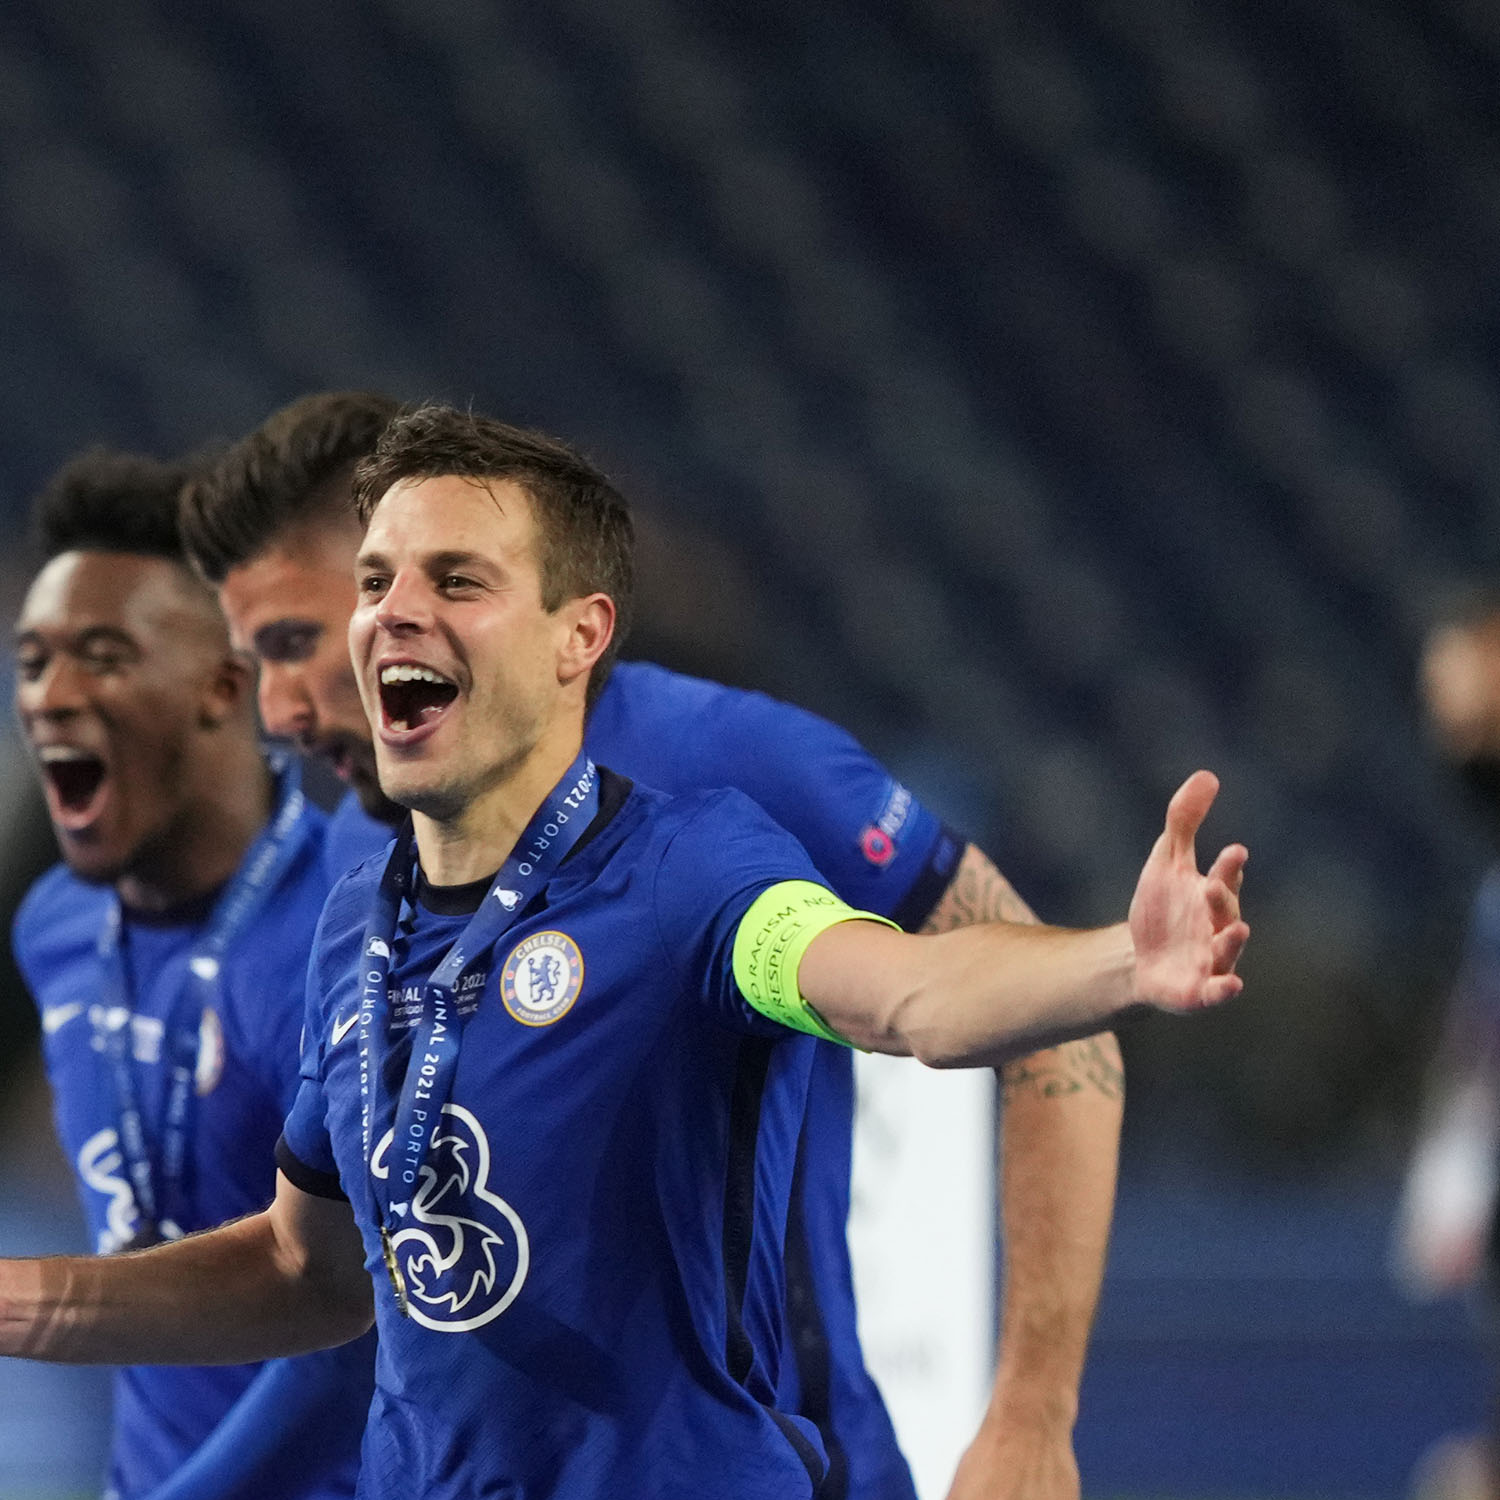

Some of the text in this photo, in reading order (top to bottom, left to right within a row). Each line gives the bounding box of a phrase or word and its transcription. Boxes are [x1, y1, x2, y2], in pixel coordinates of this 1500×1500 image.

[518, 811, 568, 876] PORTO
[803, 897, 835, 907] NO
[516, 934, 568, 959] CHELSEA
[750, 906, 797, 976] RACISM
[768, 922, 802, 1008] RESPECT
[360, 970, 383, 1040] PORTO
[462, 973, 486, 991] 2021
[402, 988, 448, 1184] FINAL 2021 PORTO
